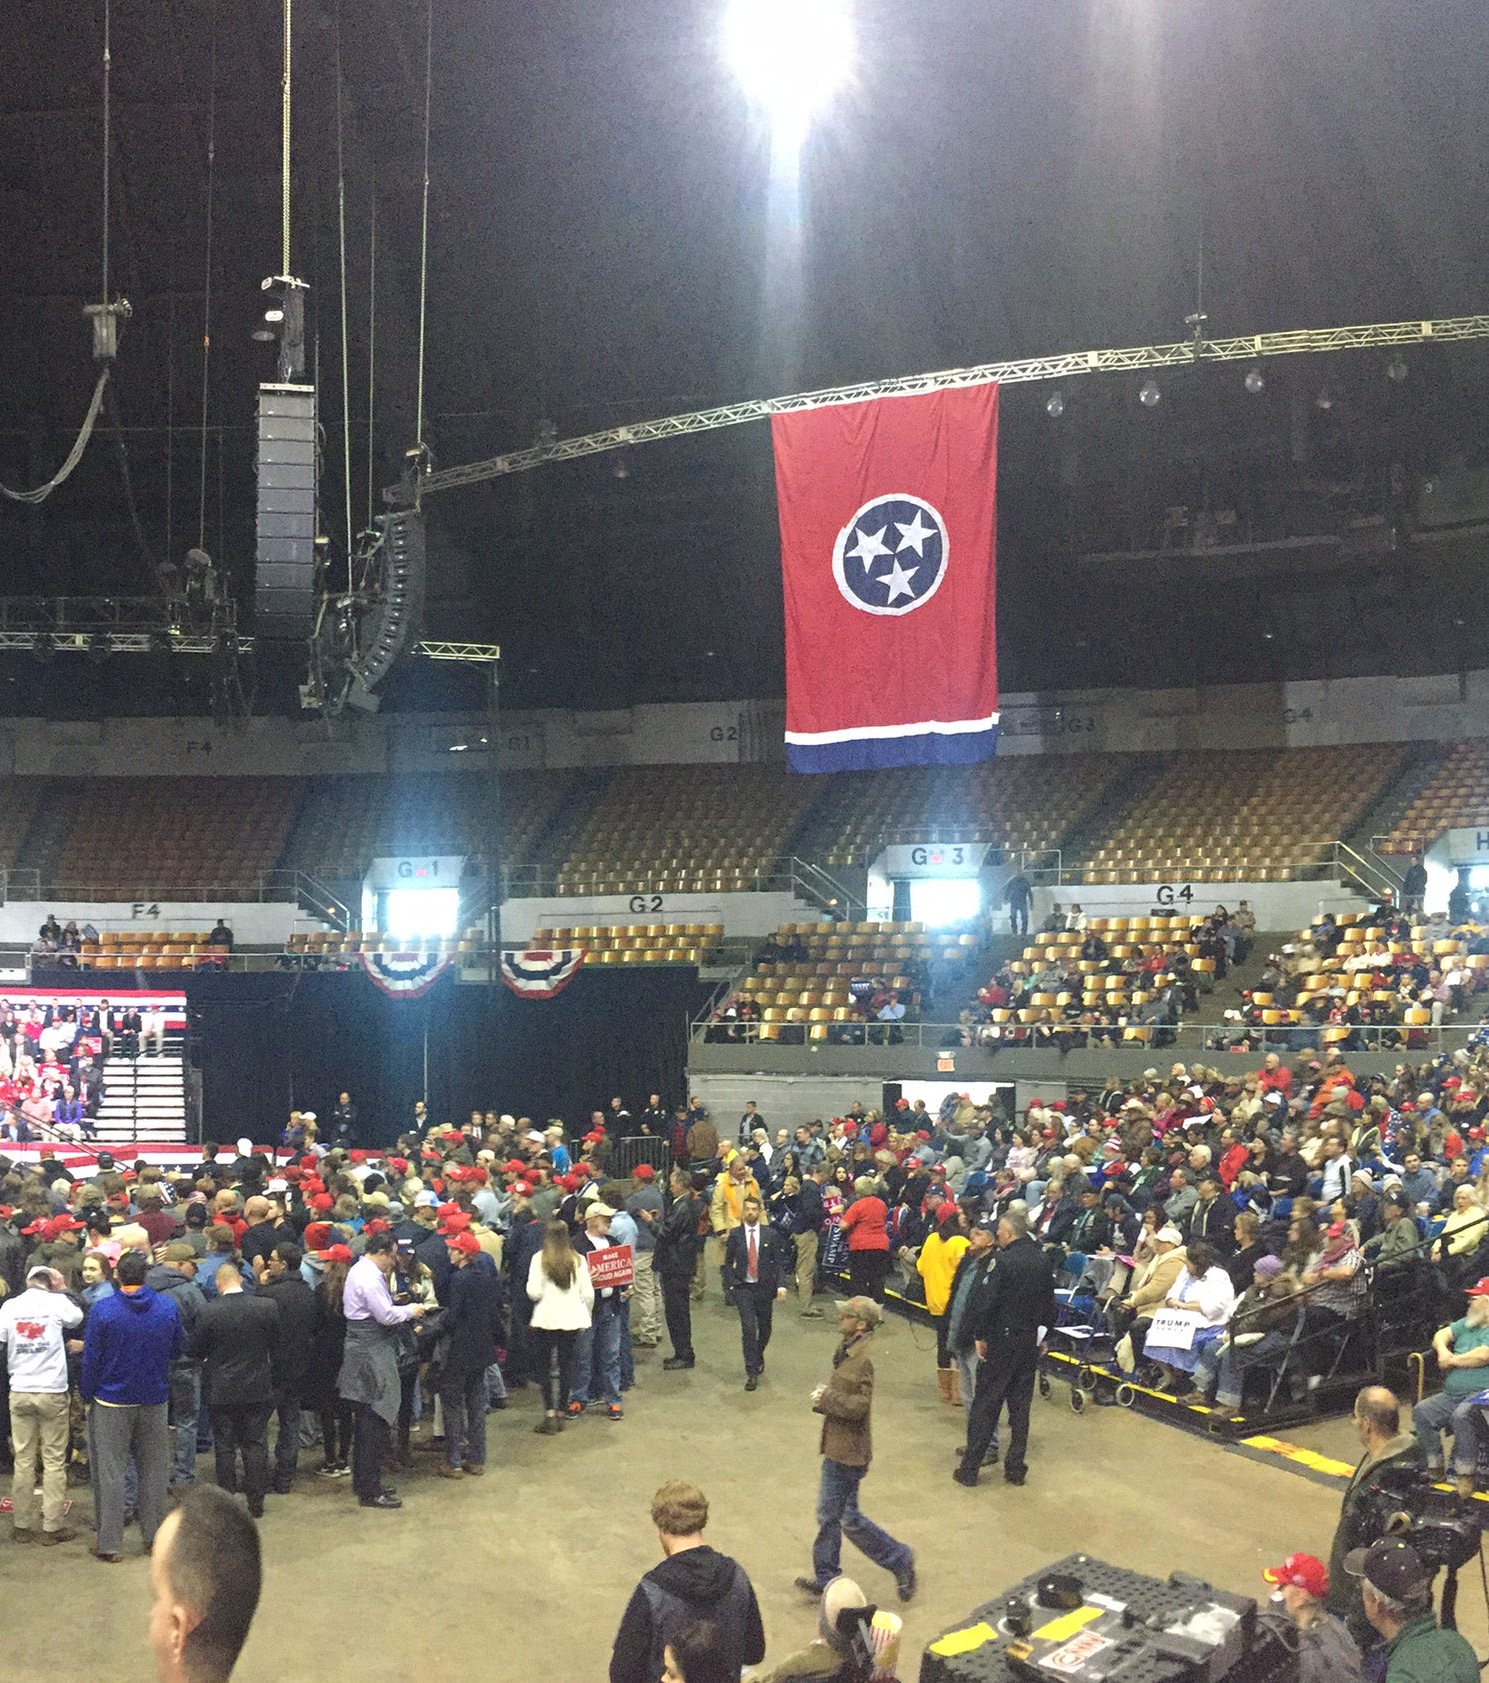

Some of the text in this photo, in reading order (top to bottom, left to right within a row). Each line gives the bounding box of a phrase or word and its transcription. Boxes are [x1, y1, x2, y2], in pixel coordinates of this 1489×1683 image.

[710, 726, 737, 741] G2
[1157, 885, 1194, 905] G4
[132, 903, 161, 919] F4
[629, 895, 663, 913] G2
[827, 1226, 842, 1264] SWAMP
[602, 1252, 619, 1261] MAKE
[596, 1258, 632, 1273] MERICA
